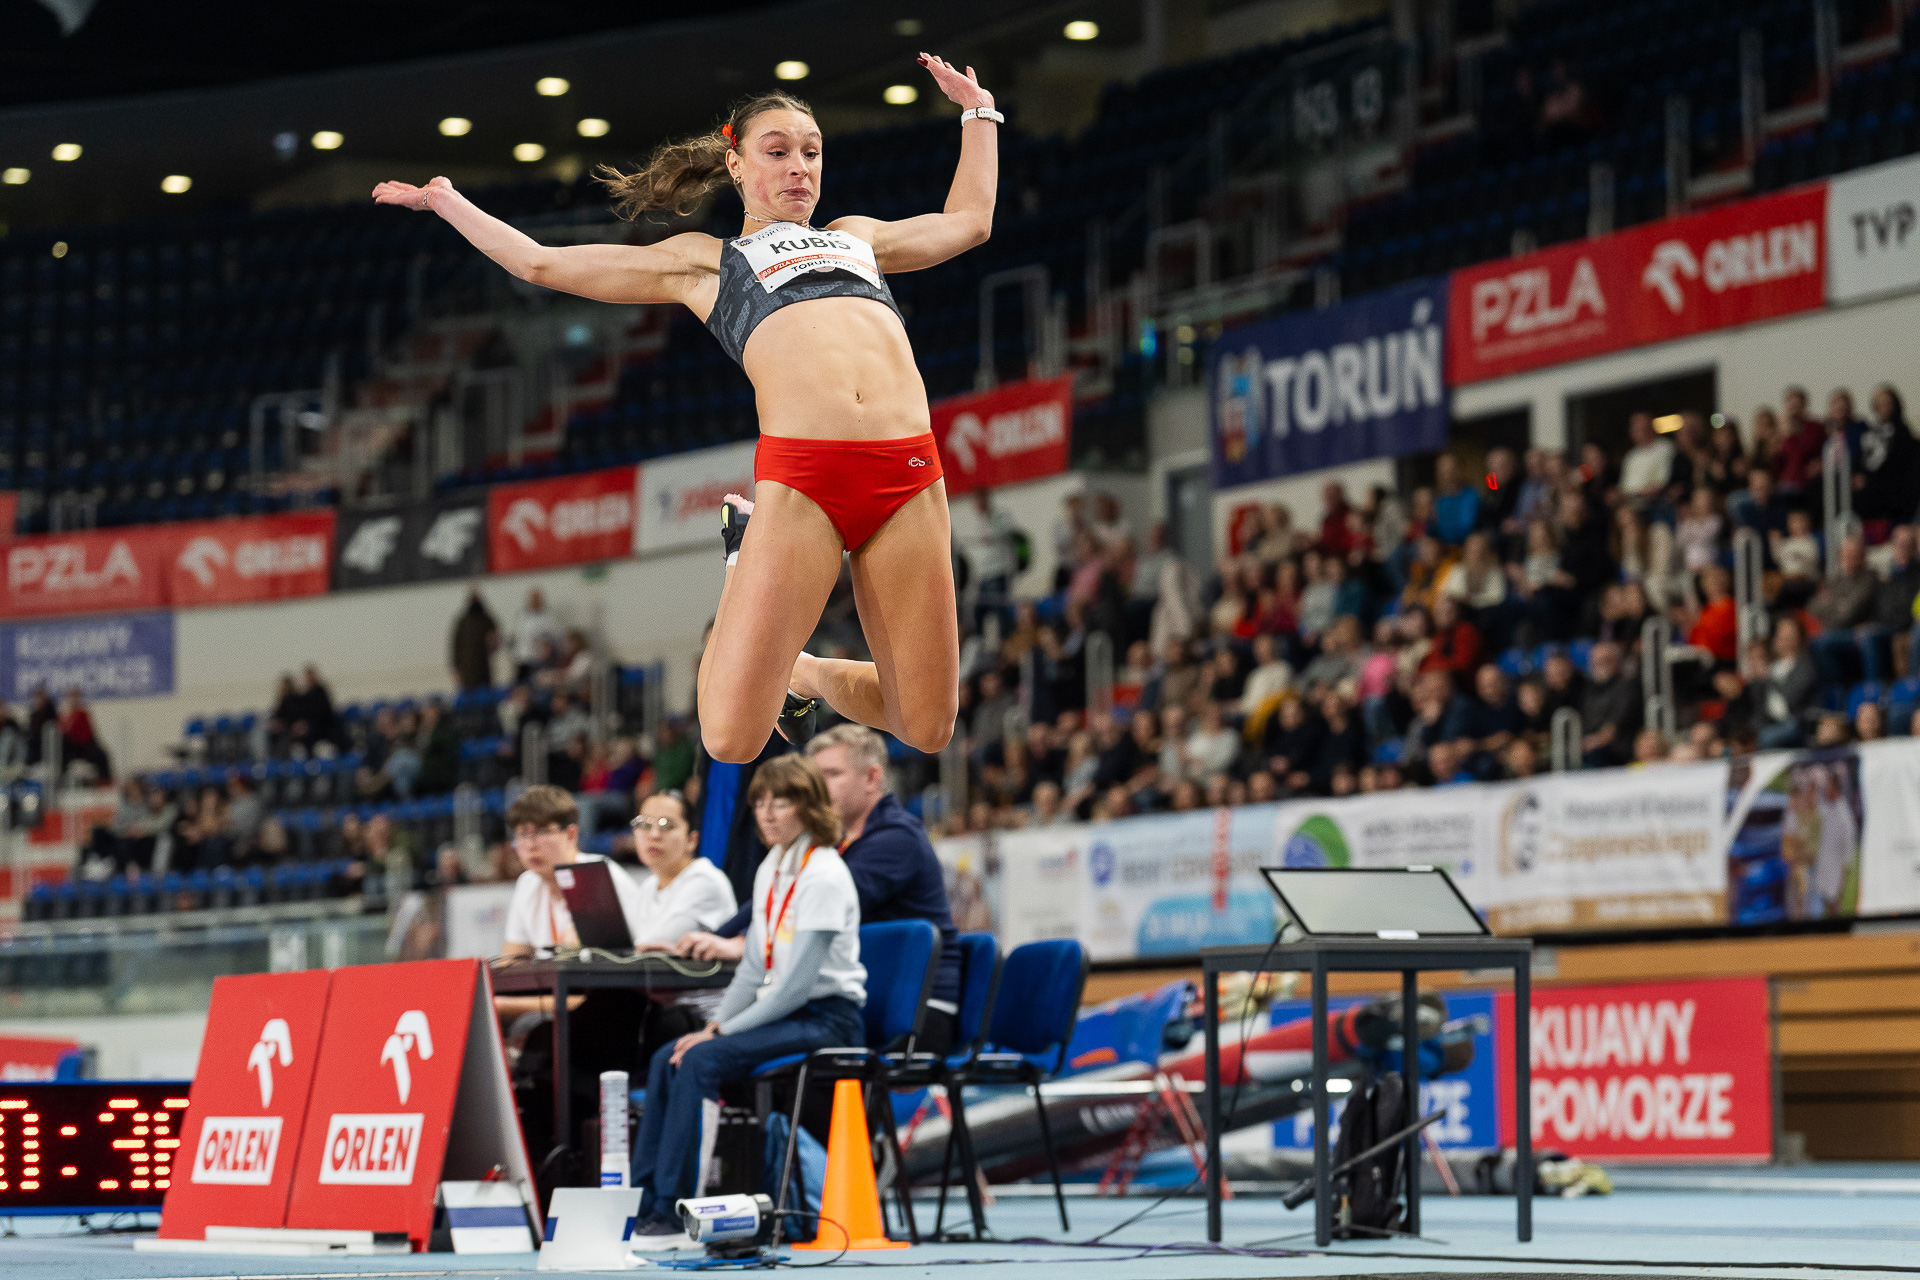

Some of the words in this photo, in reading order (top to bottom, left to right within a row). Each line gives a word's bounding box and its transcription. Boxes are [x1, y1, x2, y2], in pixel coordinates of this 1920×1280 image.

[1703, 220, 1816, 293] ORLEN
[1852, 203, 1916, 255] TVP
[1472, 258, 1606, 341] PZLA
[1266, 297, 1443, 432] TORUŃ
[8, 540, 141, 591] PZLA
[1531, 999, 1696, 1069] KUJAWY
[1531, 1073, 1734, 1142] POMORZE
[203, 1129, 273, 1172] ORLEN
[332, 1126, 413, 1172] ORLEN
